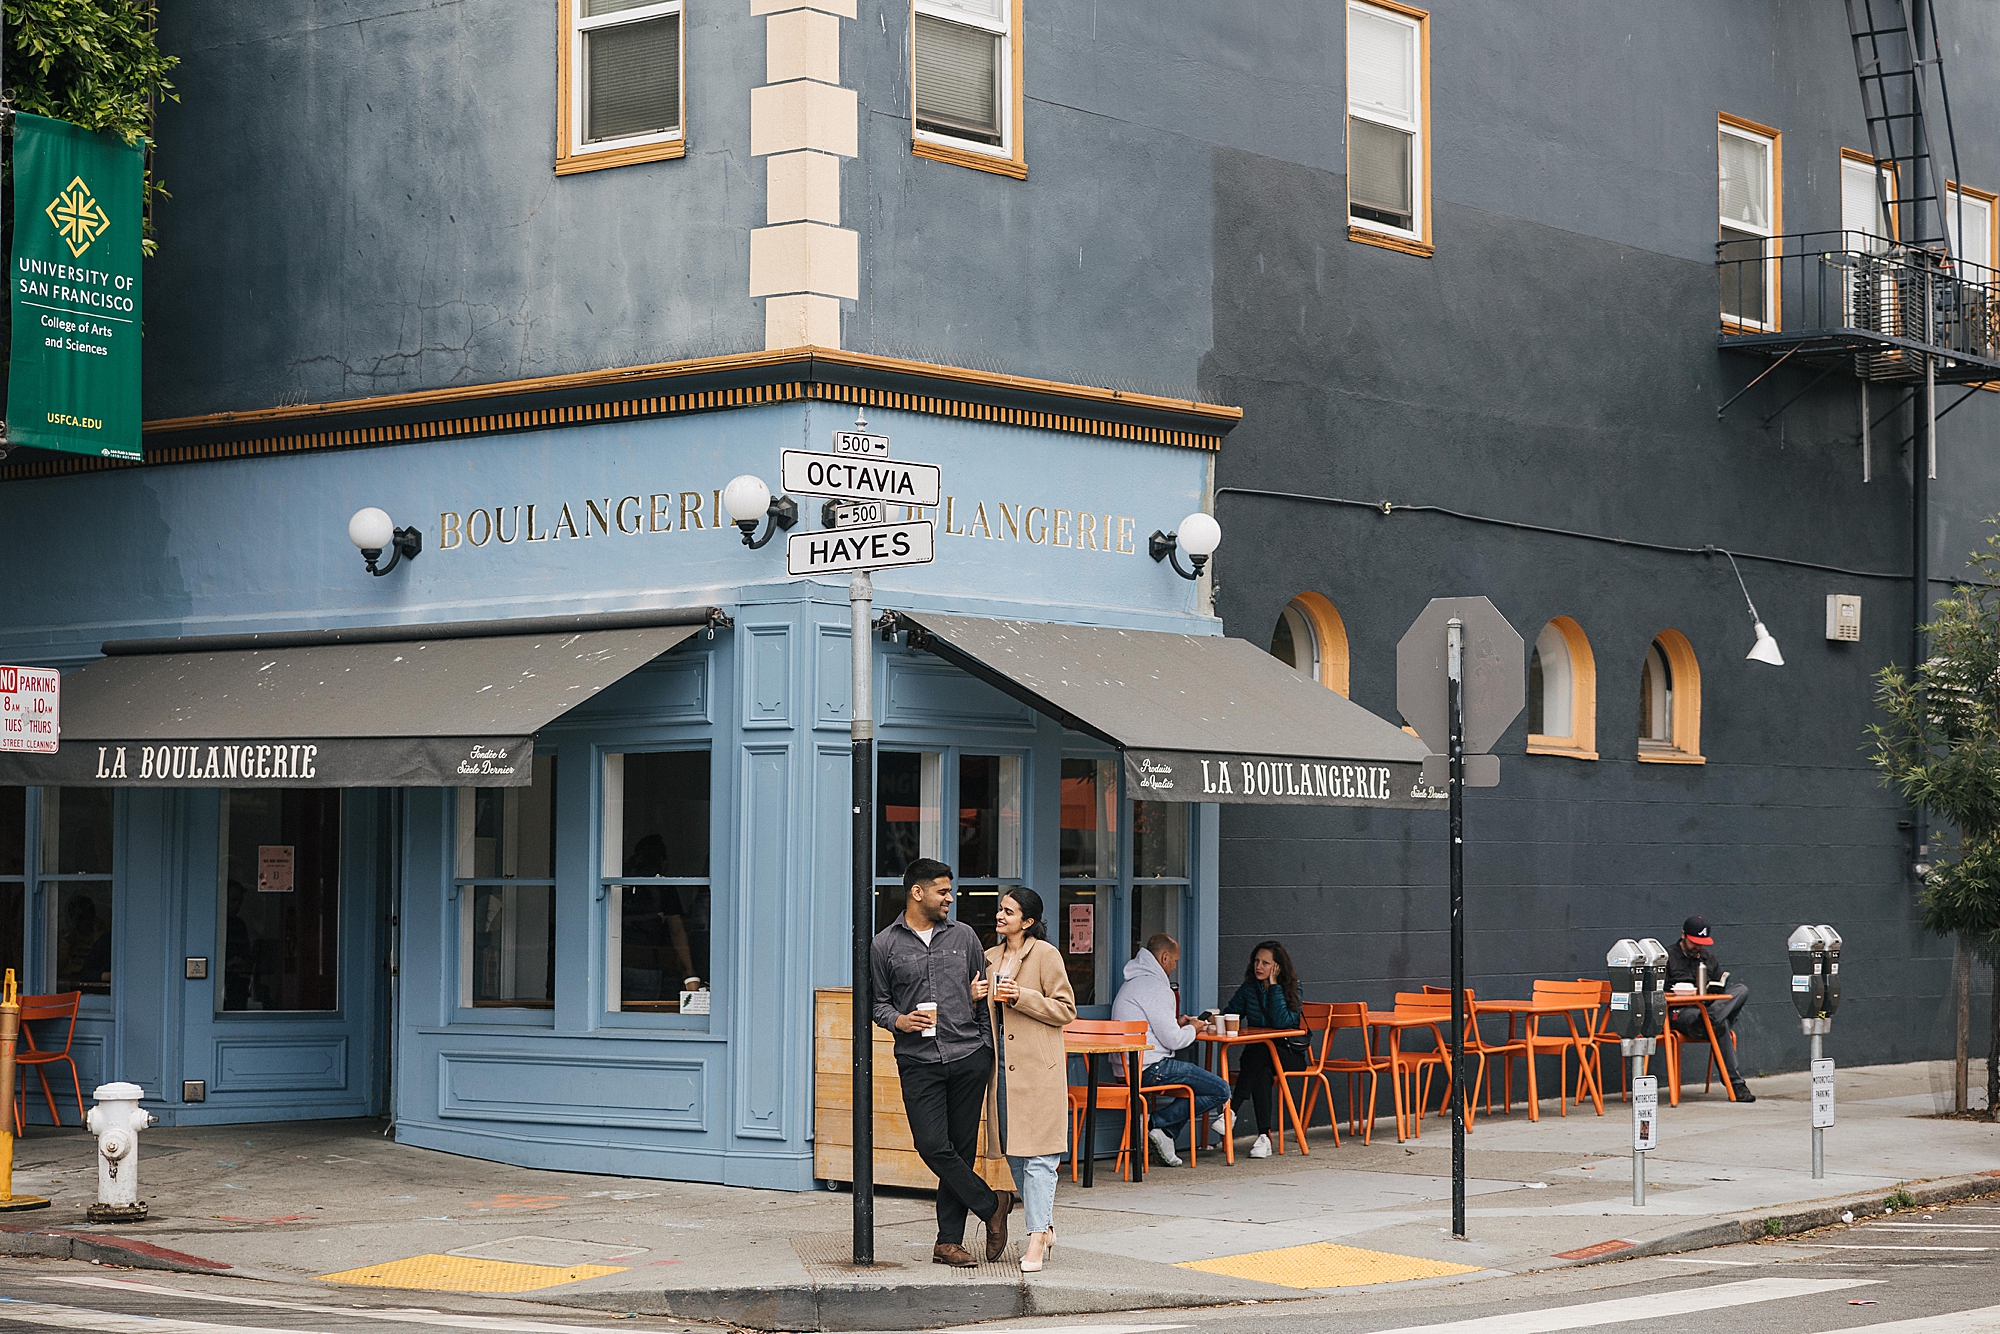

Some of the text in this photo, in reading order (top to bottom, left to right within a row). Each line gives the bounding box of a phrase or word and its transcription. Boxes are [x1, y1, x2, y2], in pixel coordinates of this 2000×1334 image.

[19, 257, 134, 291] UNIVERSITY OF
[19, 278, 134, 312] SAN FRANCISCO
[41, 314, 113, 337] College of Arts
[45, 335, 108, 356] and Sciences
[47, 412, 103, 430] USFCA.EDU
[842, 435, 870, 453] 500
[807, 461, 915, 496] OCTAVIA
[440, 489, 738, 550] BOULANGERI
[852, 505, 877, 523] 500
[809, 531, 911, 565] HAYES
[0, 669, 56, 693] NO PARKING
[4, 718, 52, 734] TUES THURS
[3, 738, 54, 749] STREET CLEANING
[95, 744, 318, 779] LA BOULANGERIE
[498, 748, 507, 759] le
[481, 760, 515, 774] Dernier
[1140, 758, 1172, 774] Produits
[1140, 774, 1174, 790] de Qualité
[1200, 759, 1391, 800] LA BOULANGERIE
[1697, 927, 1708, 937] A
[1813, 1075, 1834, 1084] MOTORCYCLE
[1635, 1093, 1656, 1103] MOTORCYCLE
[1816, 1089, 1830, 1098] PARKING
[1637, 1109, 1652, 1118] PARKING
